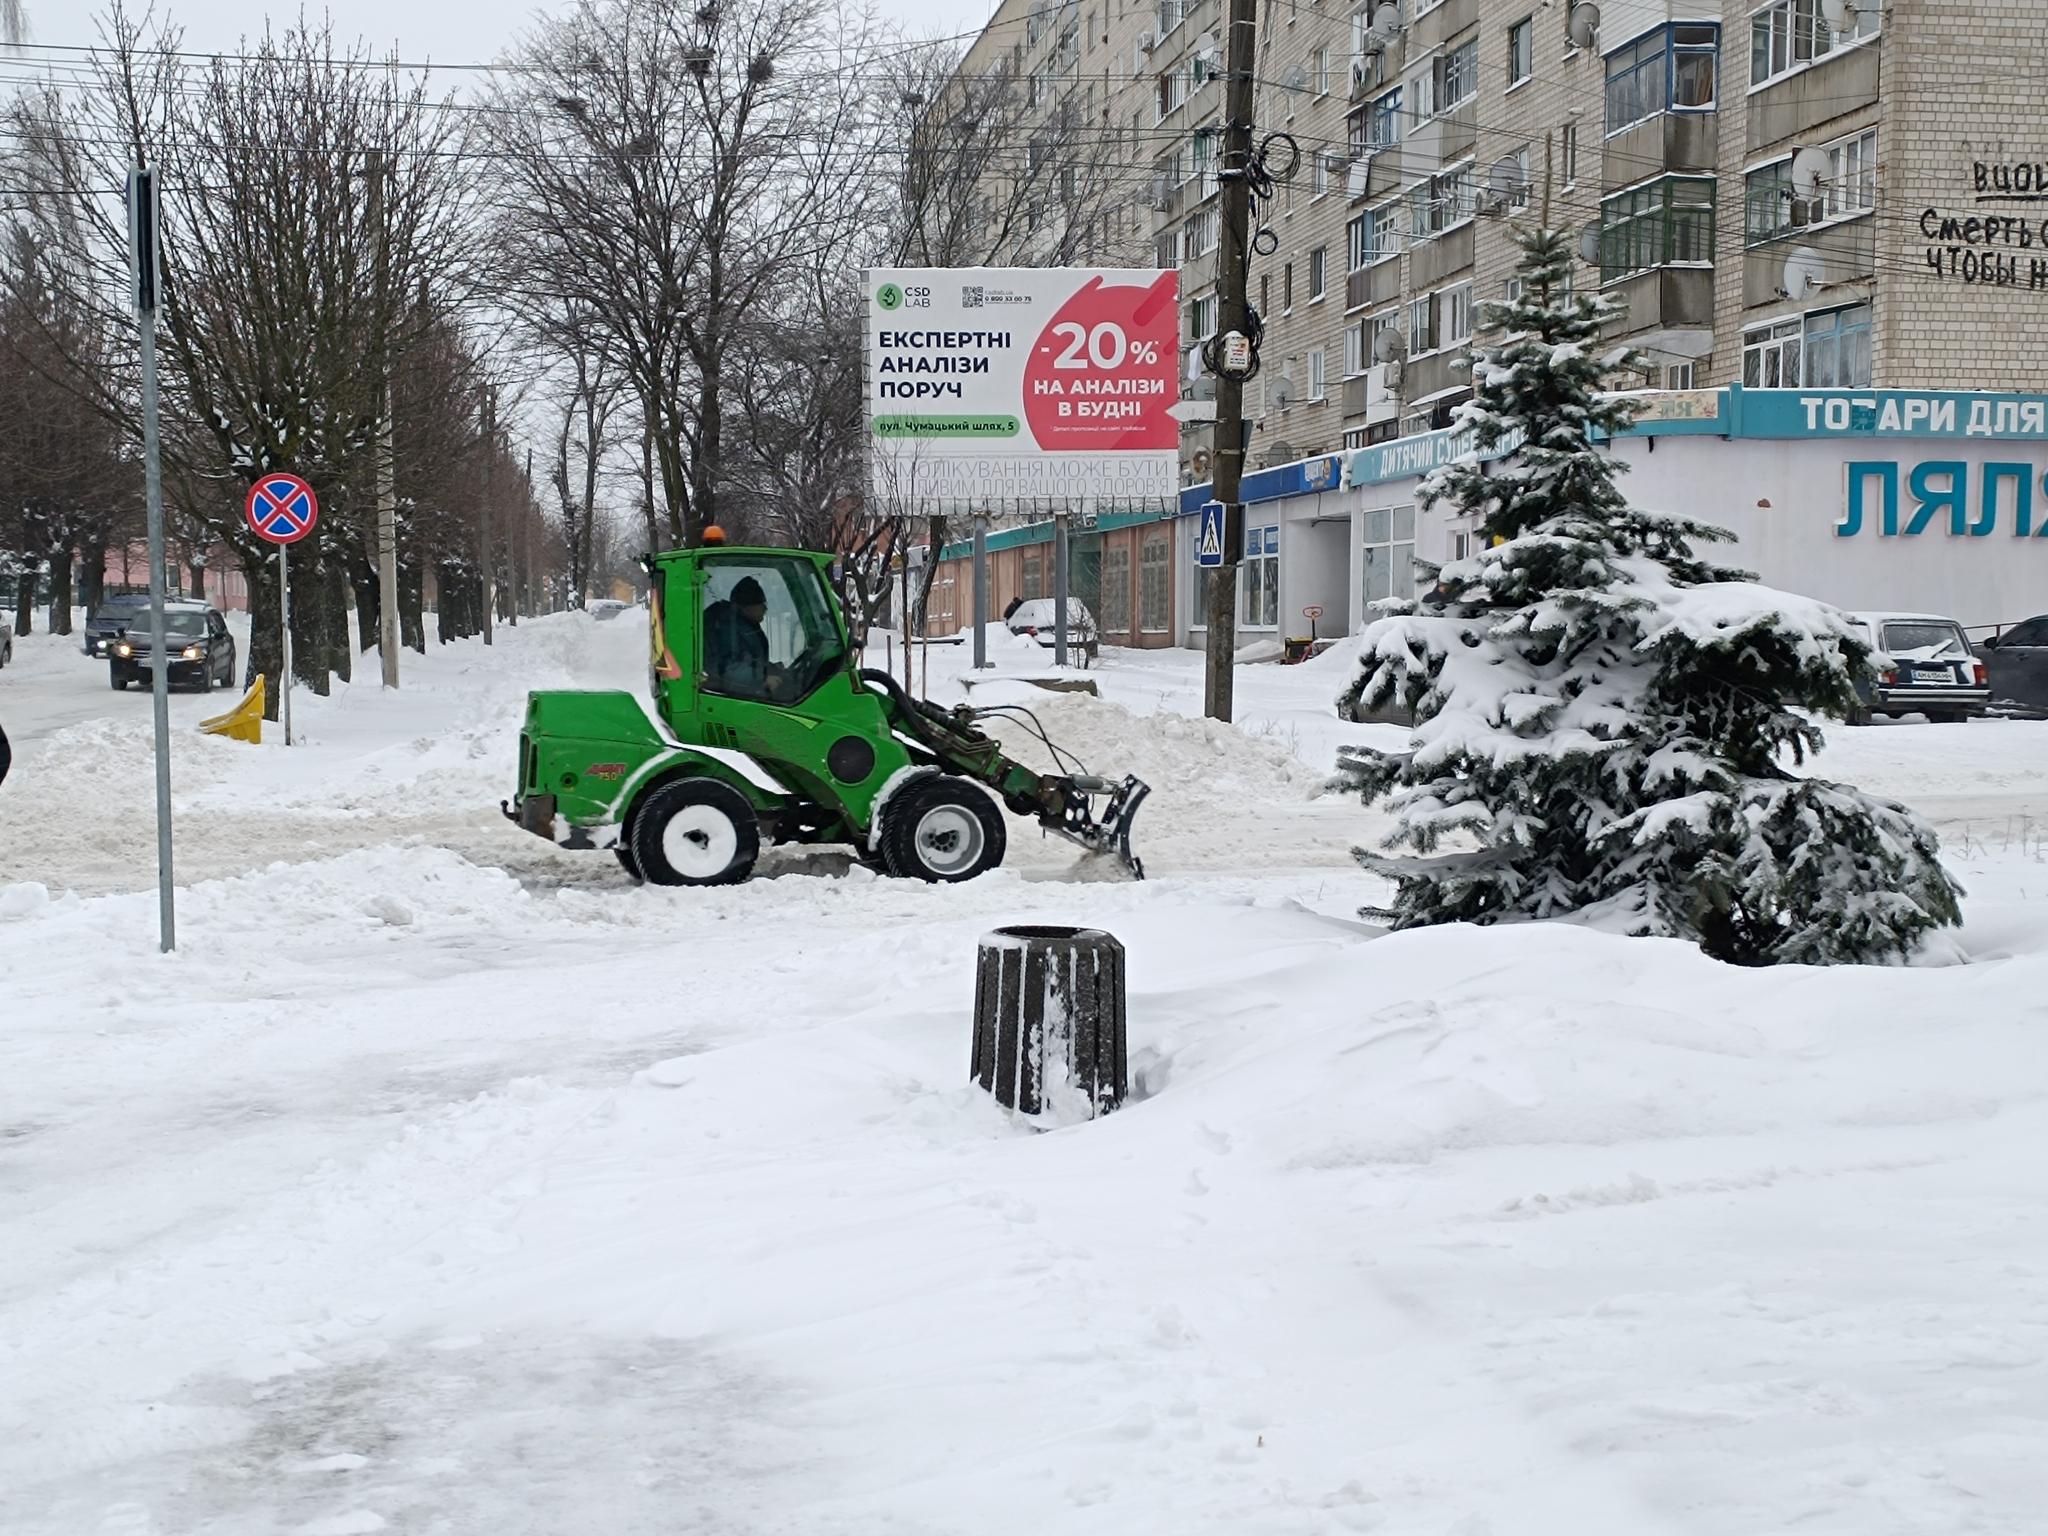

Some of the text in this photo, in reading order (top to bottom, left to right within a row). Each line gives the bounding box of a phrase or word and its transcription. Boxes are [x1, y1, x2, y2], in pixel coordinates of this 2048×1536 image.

[904, 286, 931, 297] CSD
[904, 297, 931, 308] LAB
[879, 331, 1011, 348] ЕКСПЕРТНІ
[879, 356, 989, 373] АНАЛІЗИ
[880, 381, 962, 398] ПОРУЧ
[1034, 379, 1165, 394] НА АНАЛІЗИ
[1058, 401, 1142, 419] В БУДНІ
[1966, 400, 2045, 437] ДЛЯ
[879, 420, 1015, 433] вул. Чумацький шлях, 5
[1380, 438, 1433, 478] ДИТЯЧИЙ
[1050, 460, 1114, 478] МОЖЕ
[1119, 459, 1169, 478] БУТИ
[981, 479, 1014, 497] ДЛЯ
[1018, 478, 1087, 496] ВАШОГО
[1091, 478, 1170, 496] ЗДОРОВ'Я
[1836, 460, 2048, 538] ЛЯЛ
